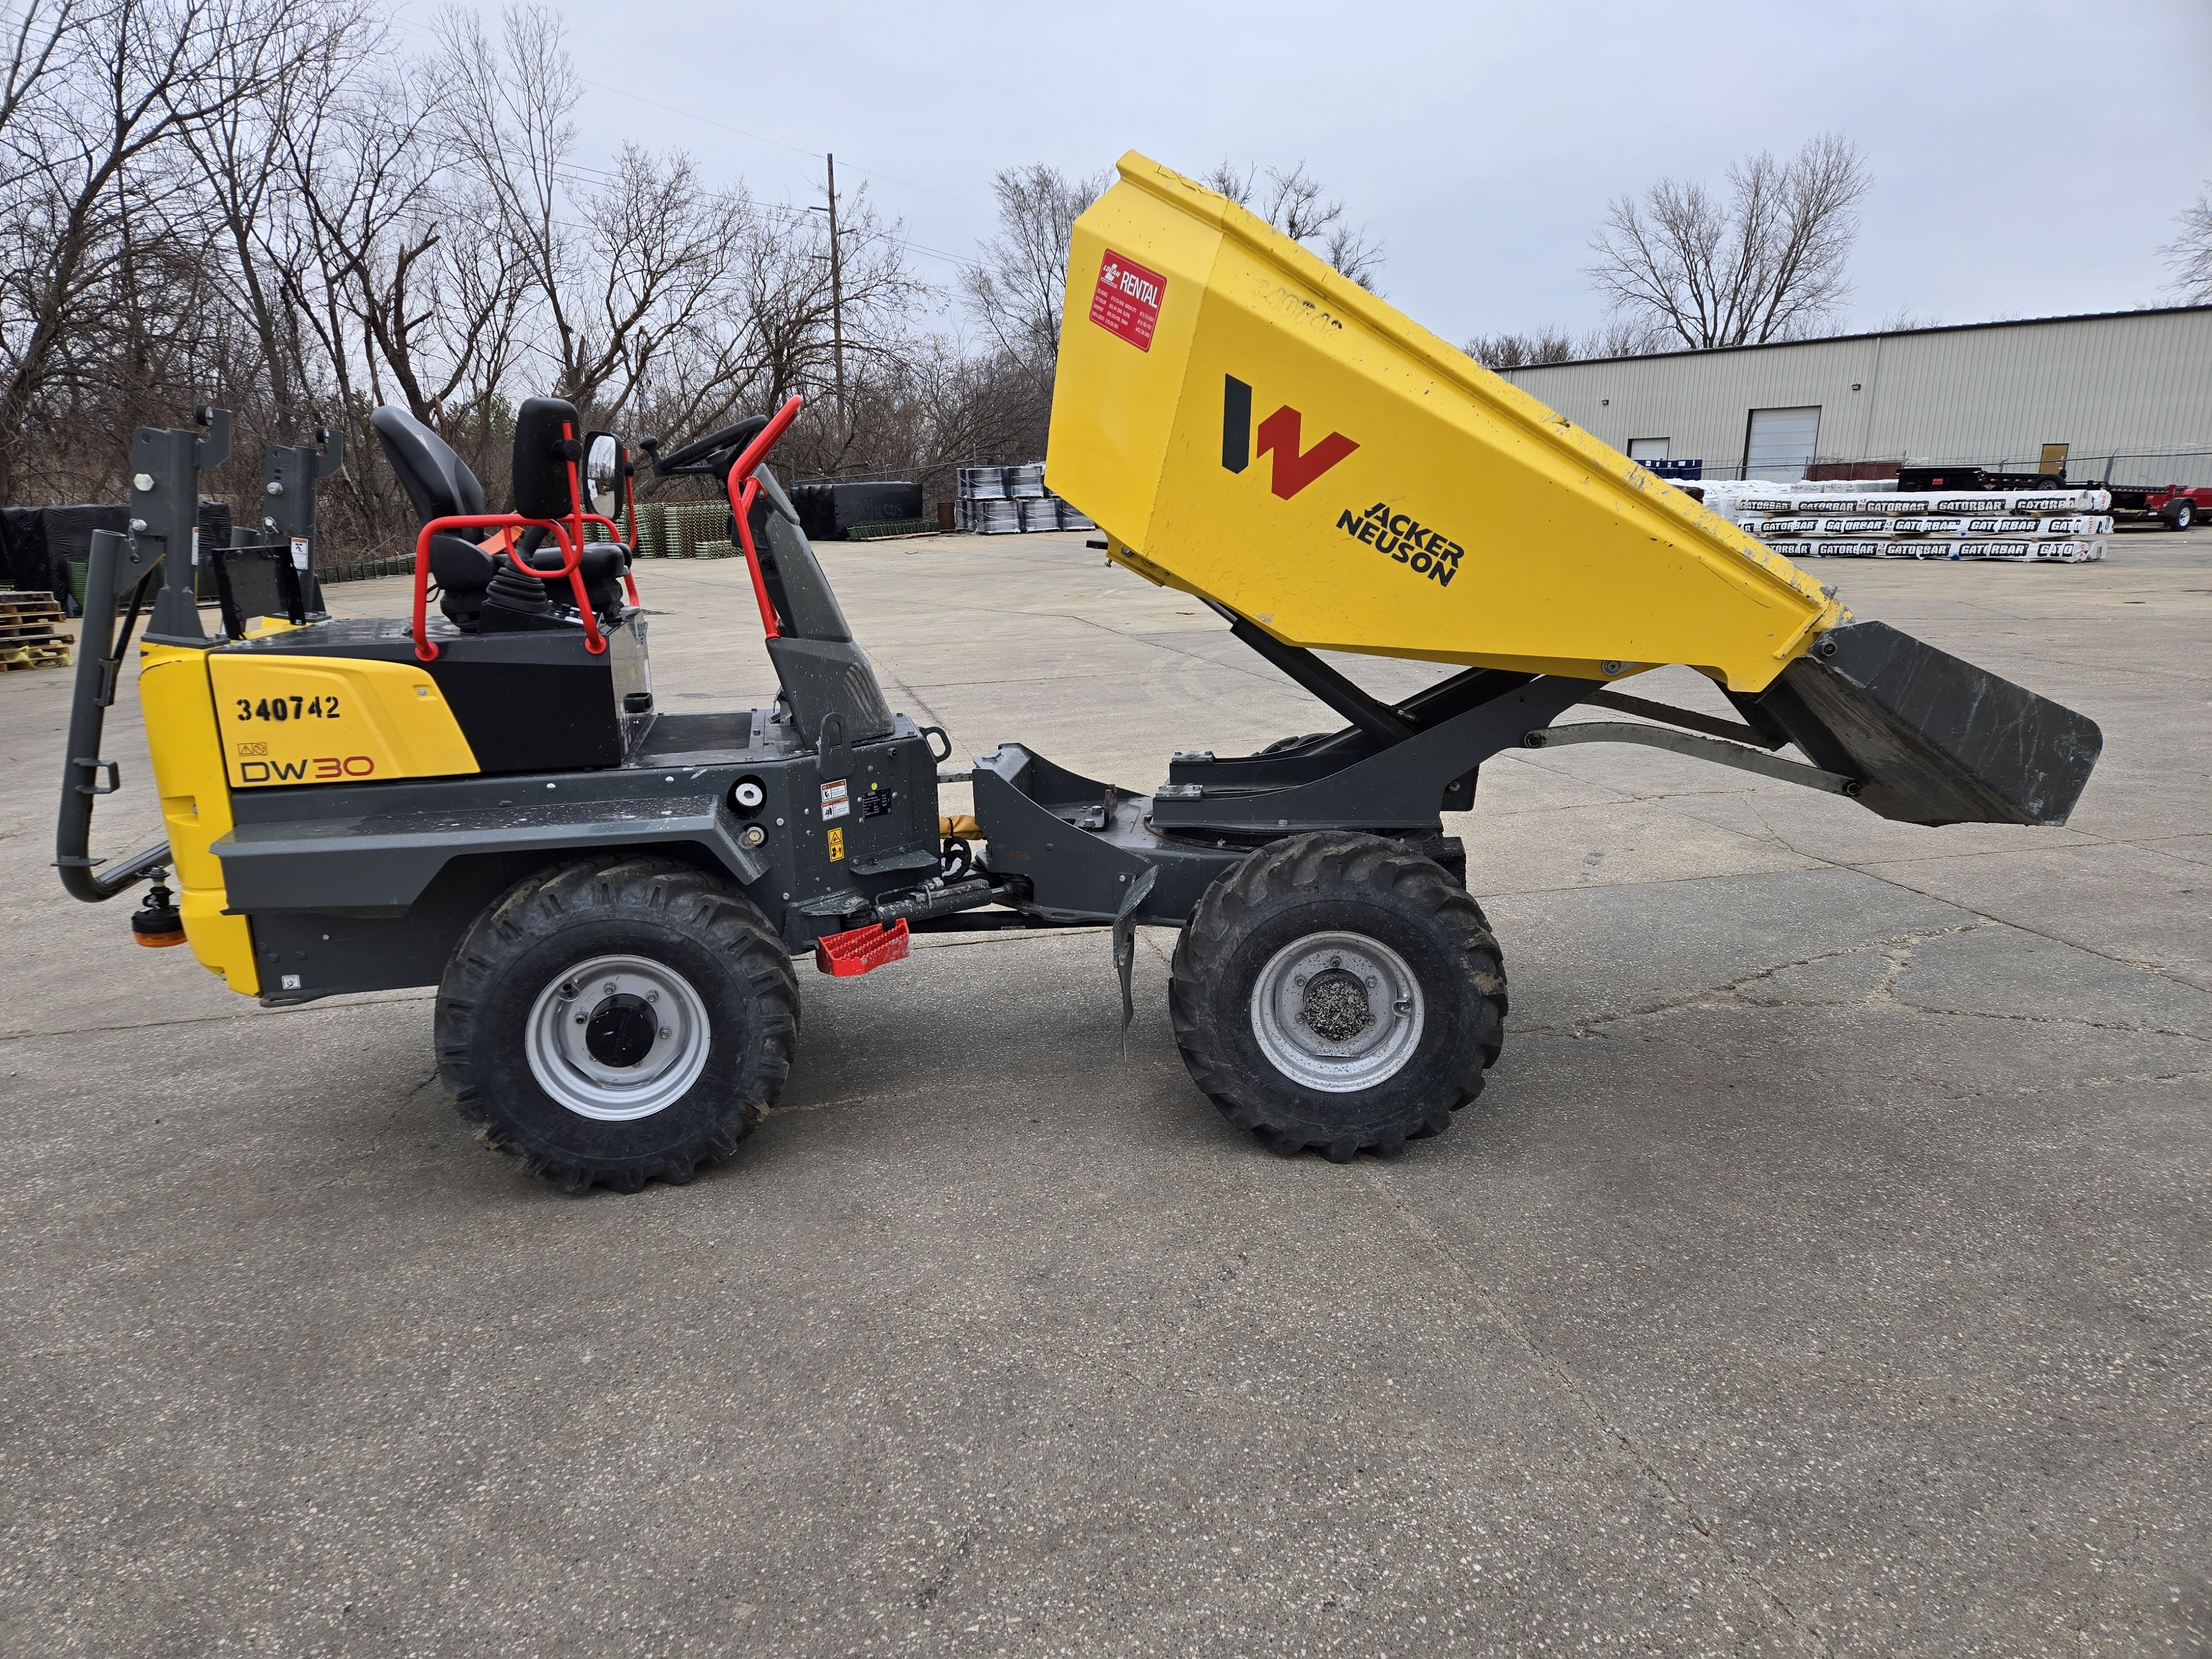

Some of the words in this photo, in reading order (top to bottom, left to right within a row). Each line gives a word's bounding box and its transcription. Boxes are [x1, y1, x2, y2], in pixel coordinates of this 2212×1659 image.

[1103, 264, 1121, 278] LOGAN
[1119, 270, 1158, 309] RENTAL
[1740, 501, 1791, 510] GATORBAR
[1800, 502, 1856, 512] GATORBAR
[1867, 503, 1928, 512] GATORBAR
[1939, 502, 2005, 511] GATORBAR
[1335, 508, 1457, 587] NEUSON
[1887, 545, 1949, 555] GATORBAR
[236, 696, 340, 721] 340742
[240, 756, 374, 782] DW30
